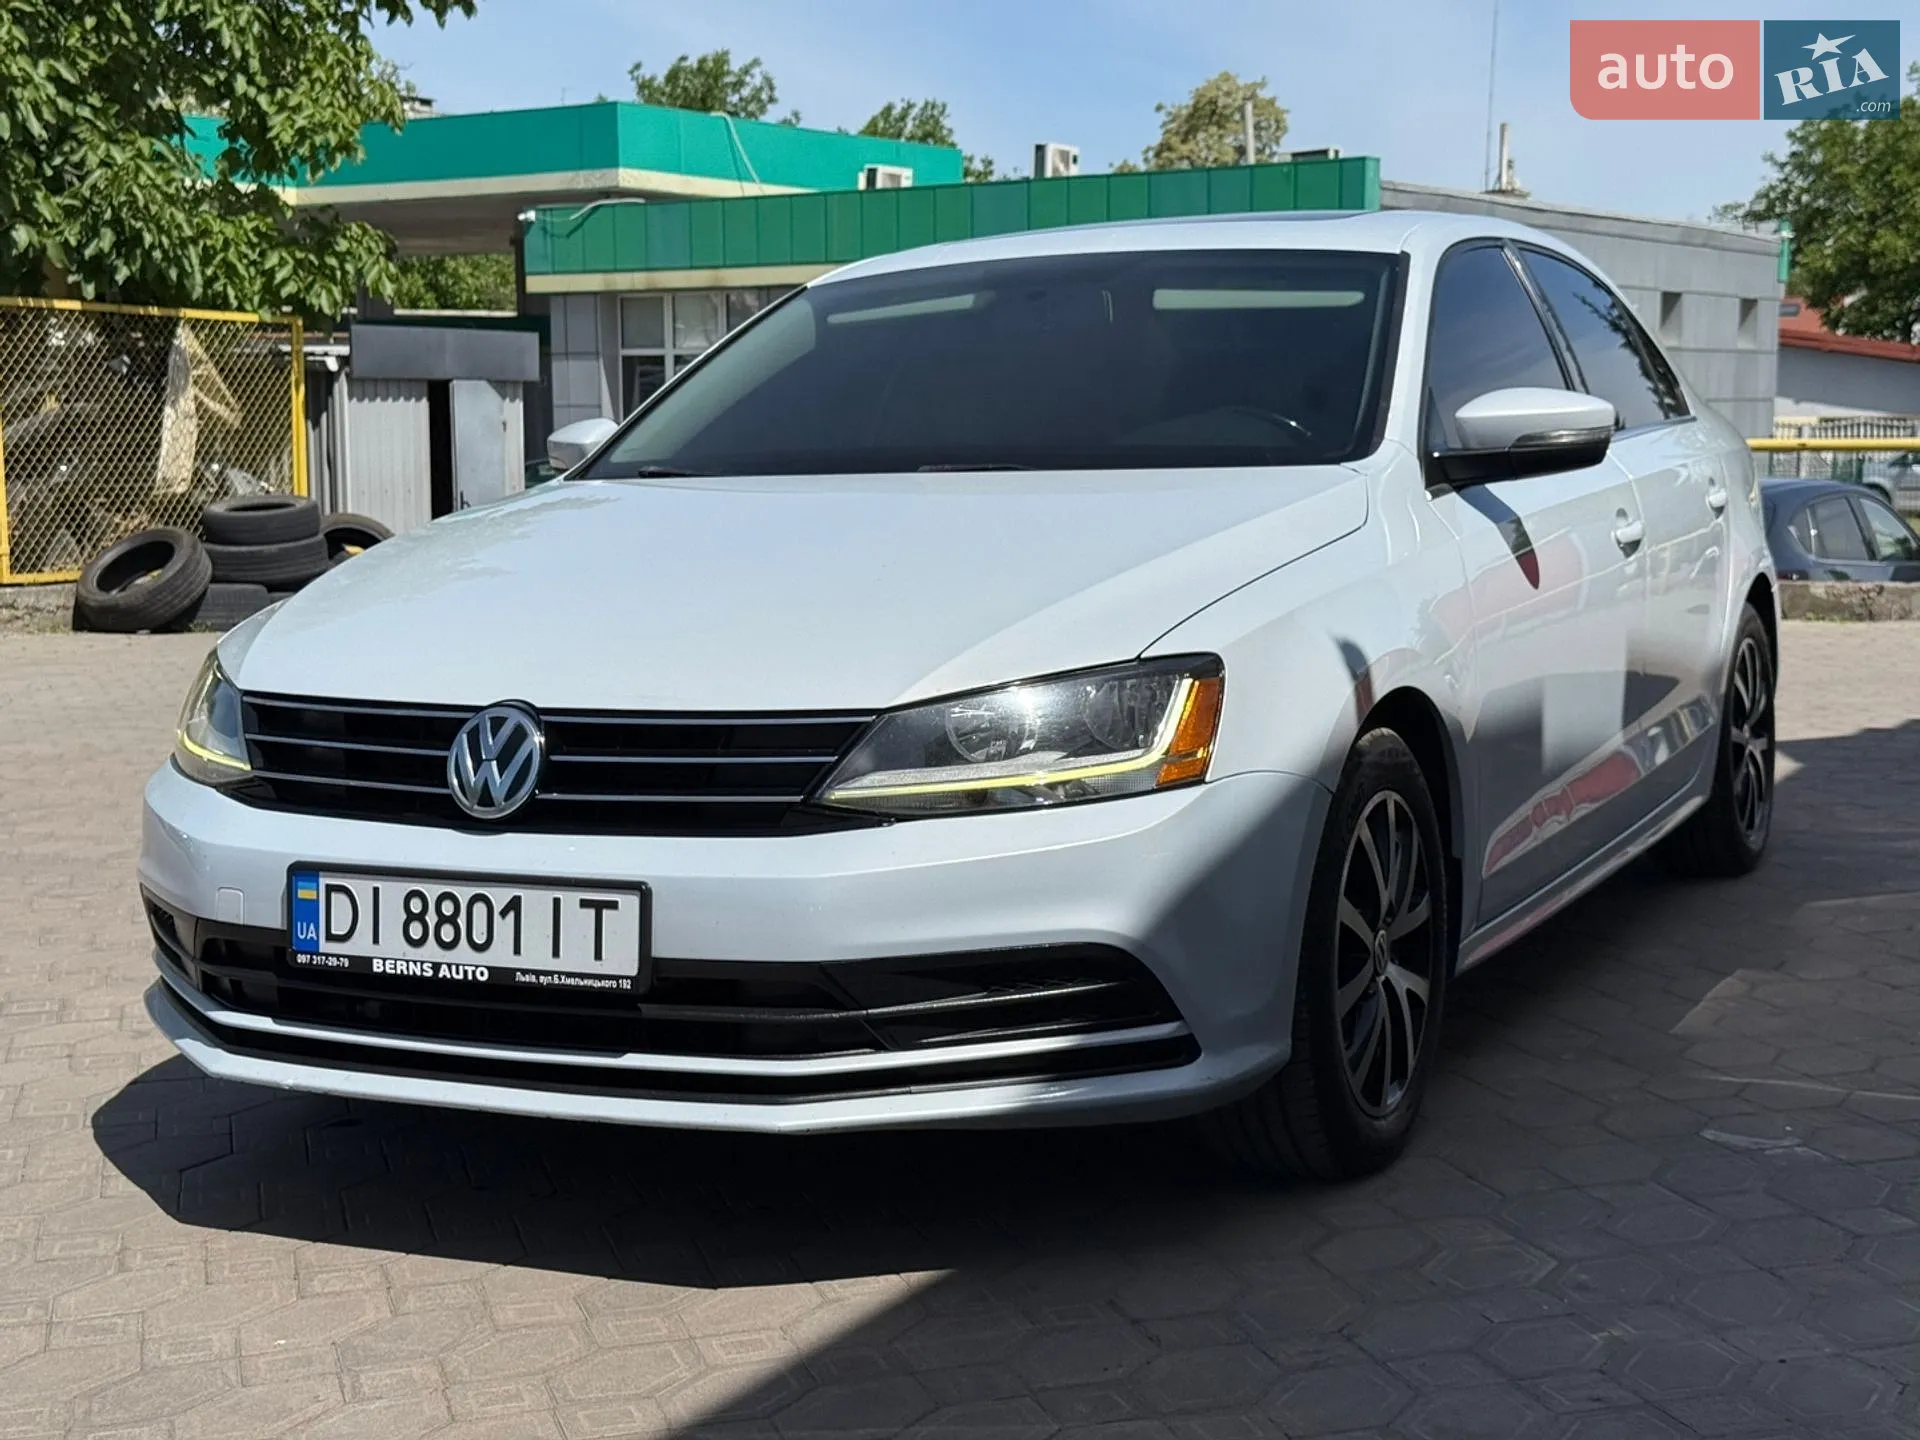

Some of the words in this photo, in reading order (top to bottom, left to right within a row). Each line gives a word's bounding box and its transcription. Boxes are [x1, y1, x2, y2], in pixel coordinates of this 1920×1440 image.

[297, 920, 318, 940] UA
[324, 883, 380, 945] DI
[402, 889, 522, 956] 8801
[552, 897, 620, 962] IT
[372, 958, 433, 977] BERNS
[438, 963, 489, 981] AUTO
